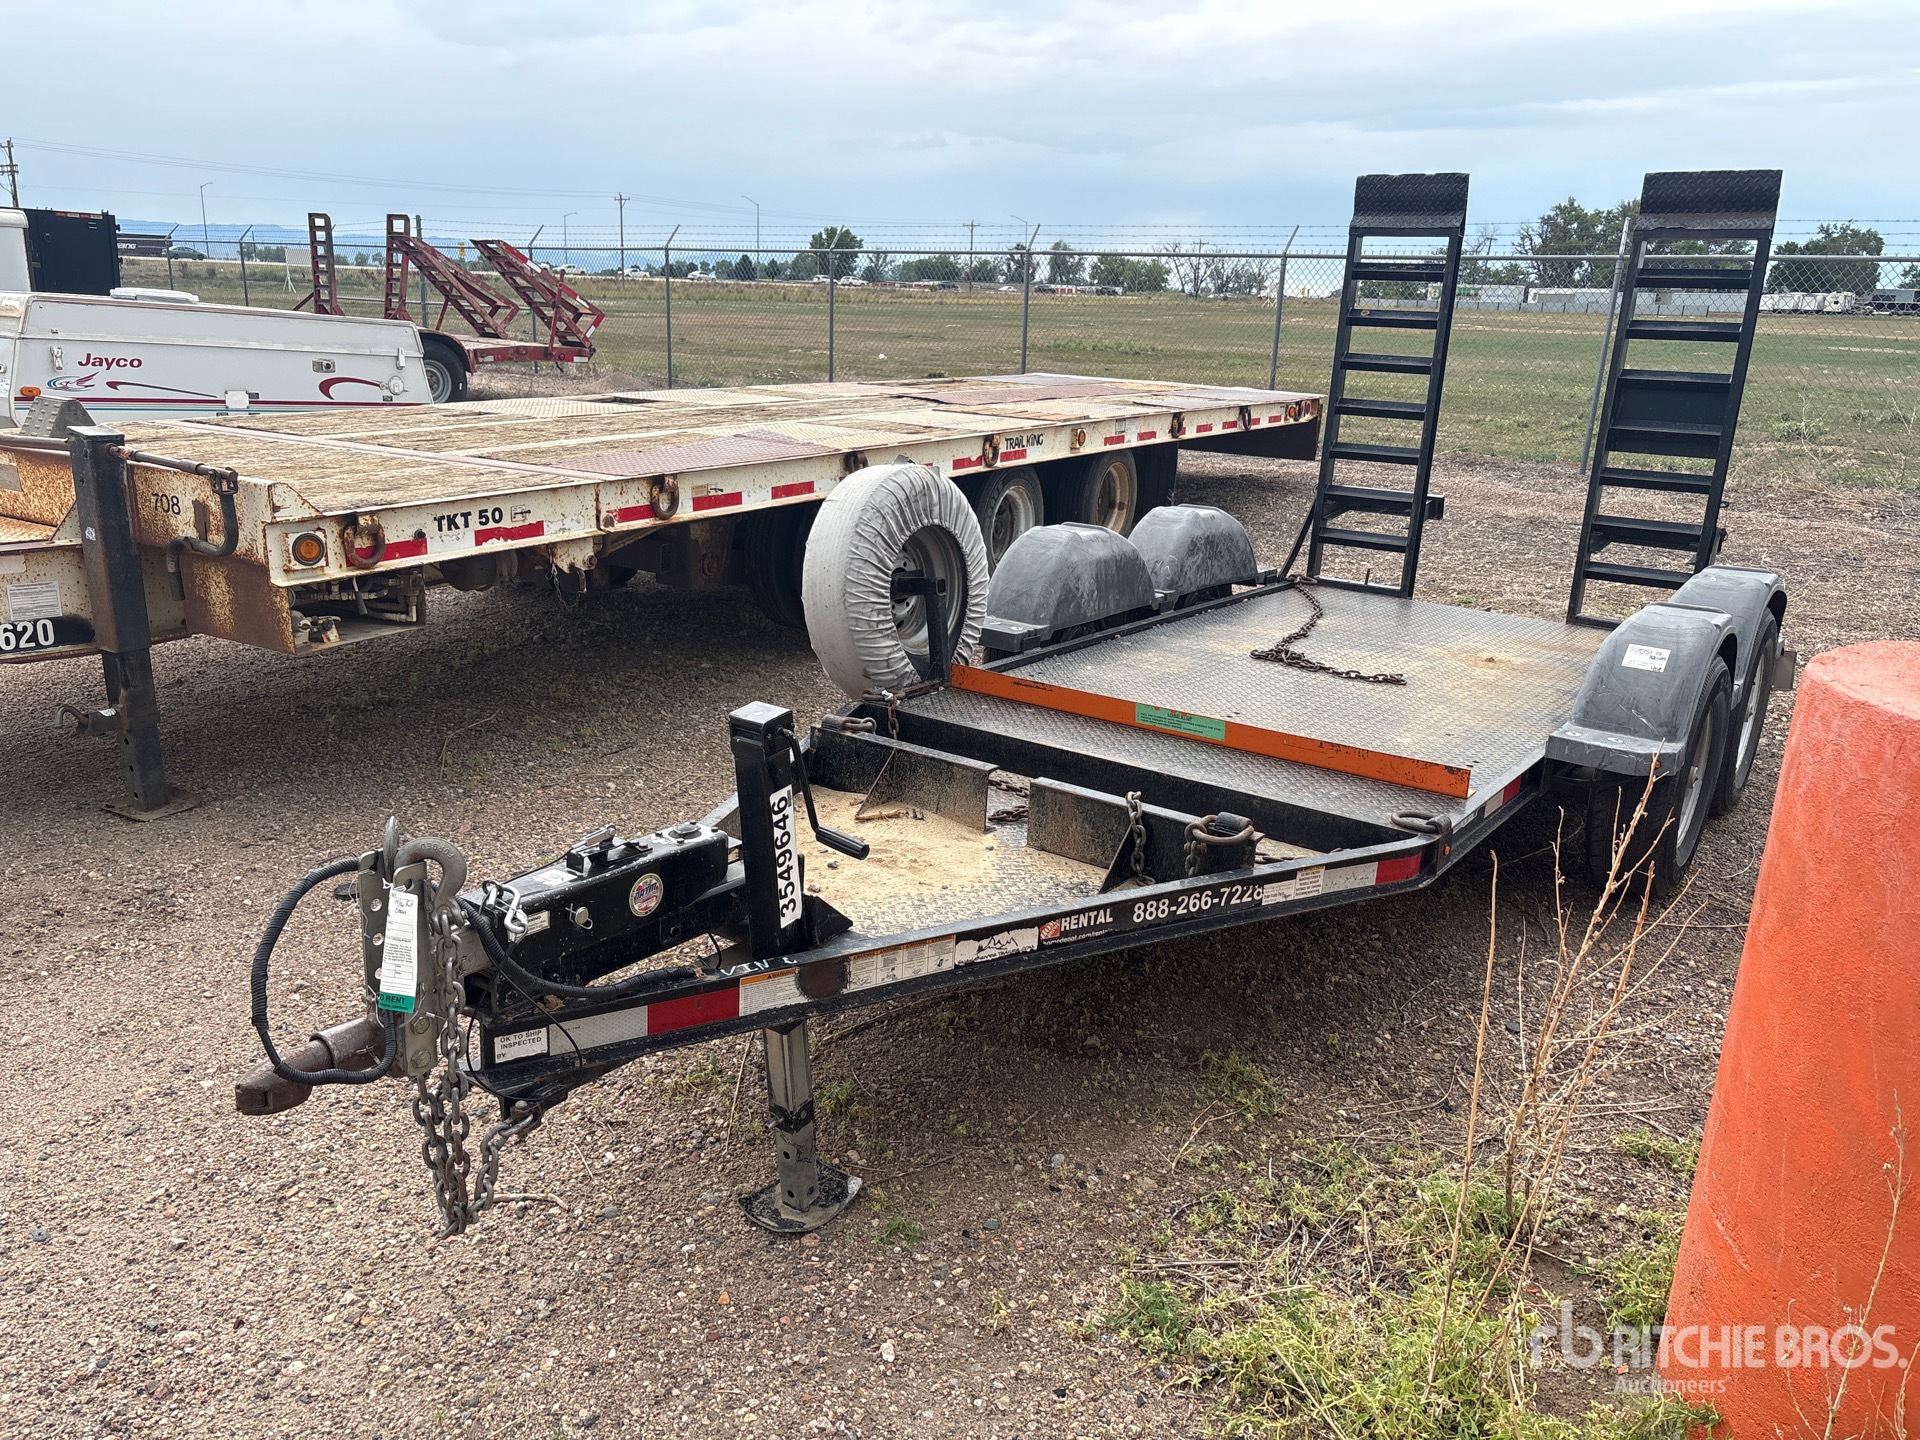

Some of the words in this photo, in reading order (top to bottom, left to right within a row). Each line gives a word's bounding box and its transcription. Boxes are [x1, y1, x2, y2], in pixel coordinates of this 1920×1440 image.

[78, 353, 142, 370] Jayco
[151, 492, 181, 515] 708
[434, 511, 472, 532] TKT
[478, 507, 503, 526] 50
[0, 619, 55, 651] 620
[771, 796, 796, 918] 3549646
[1133, 885, 1263, 923] 888-266-7228
[1061, 909, 1113, 931] RENTAL
[721, 959, 769, 976] VIN
[386, 995, 406, 1004] RENT
[501, 1036, 542, 1050] INSPECTED
